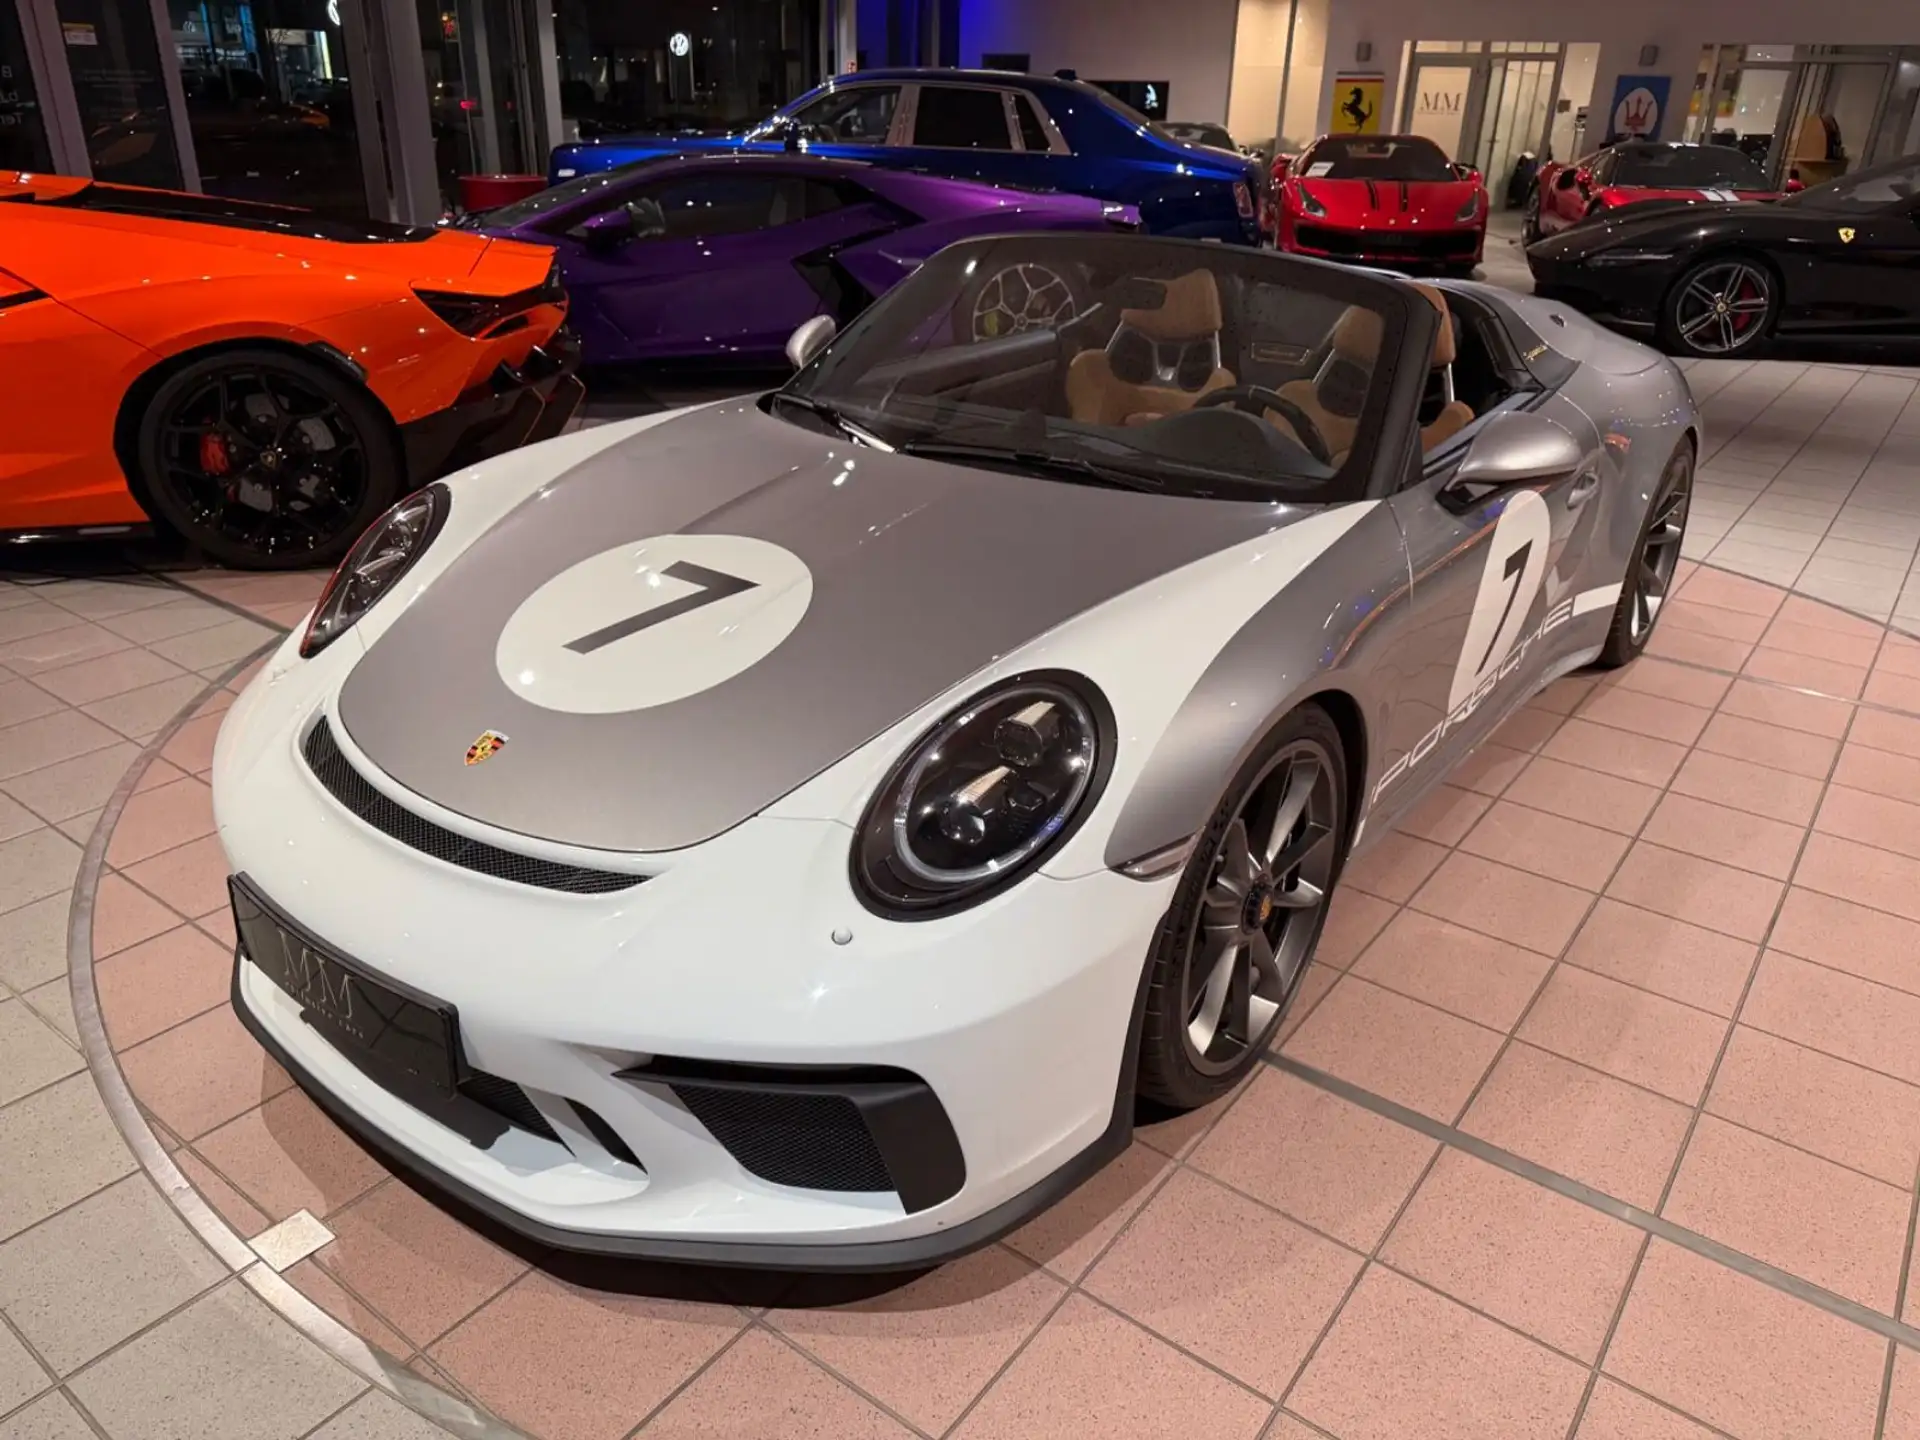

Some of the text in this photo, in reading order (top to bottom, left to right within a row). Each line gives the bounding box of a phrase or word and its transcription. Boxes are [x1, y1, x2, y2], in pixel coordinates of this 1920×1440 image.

[1419, 91, 1464, 111] MM
[561, 560, 762, 655] 7
[1474, 538, 1533, 677] 7
[1371, 597, 1573, 804] PORSCHE
